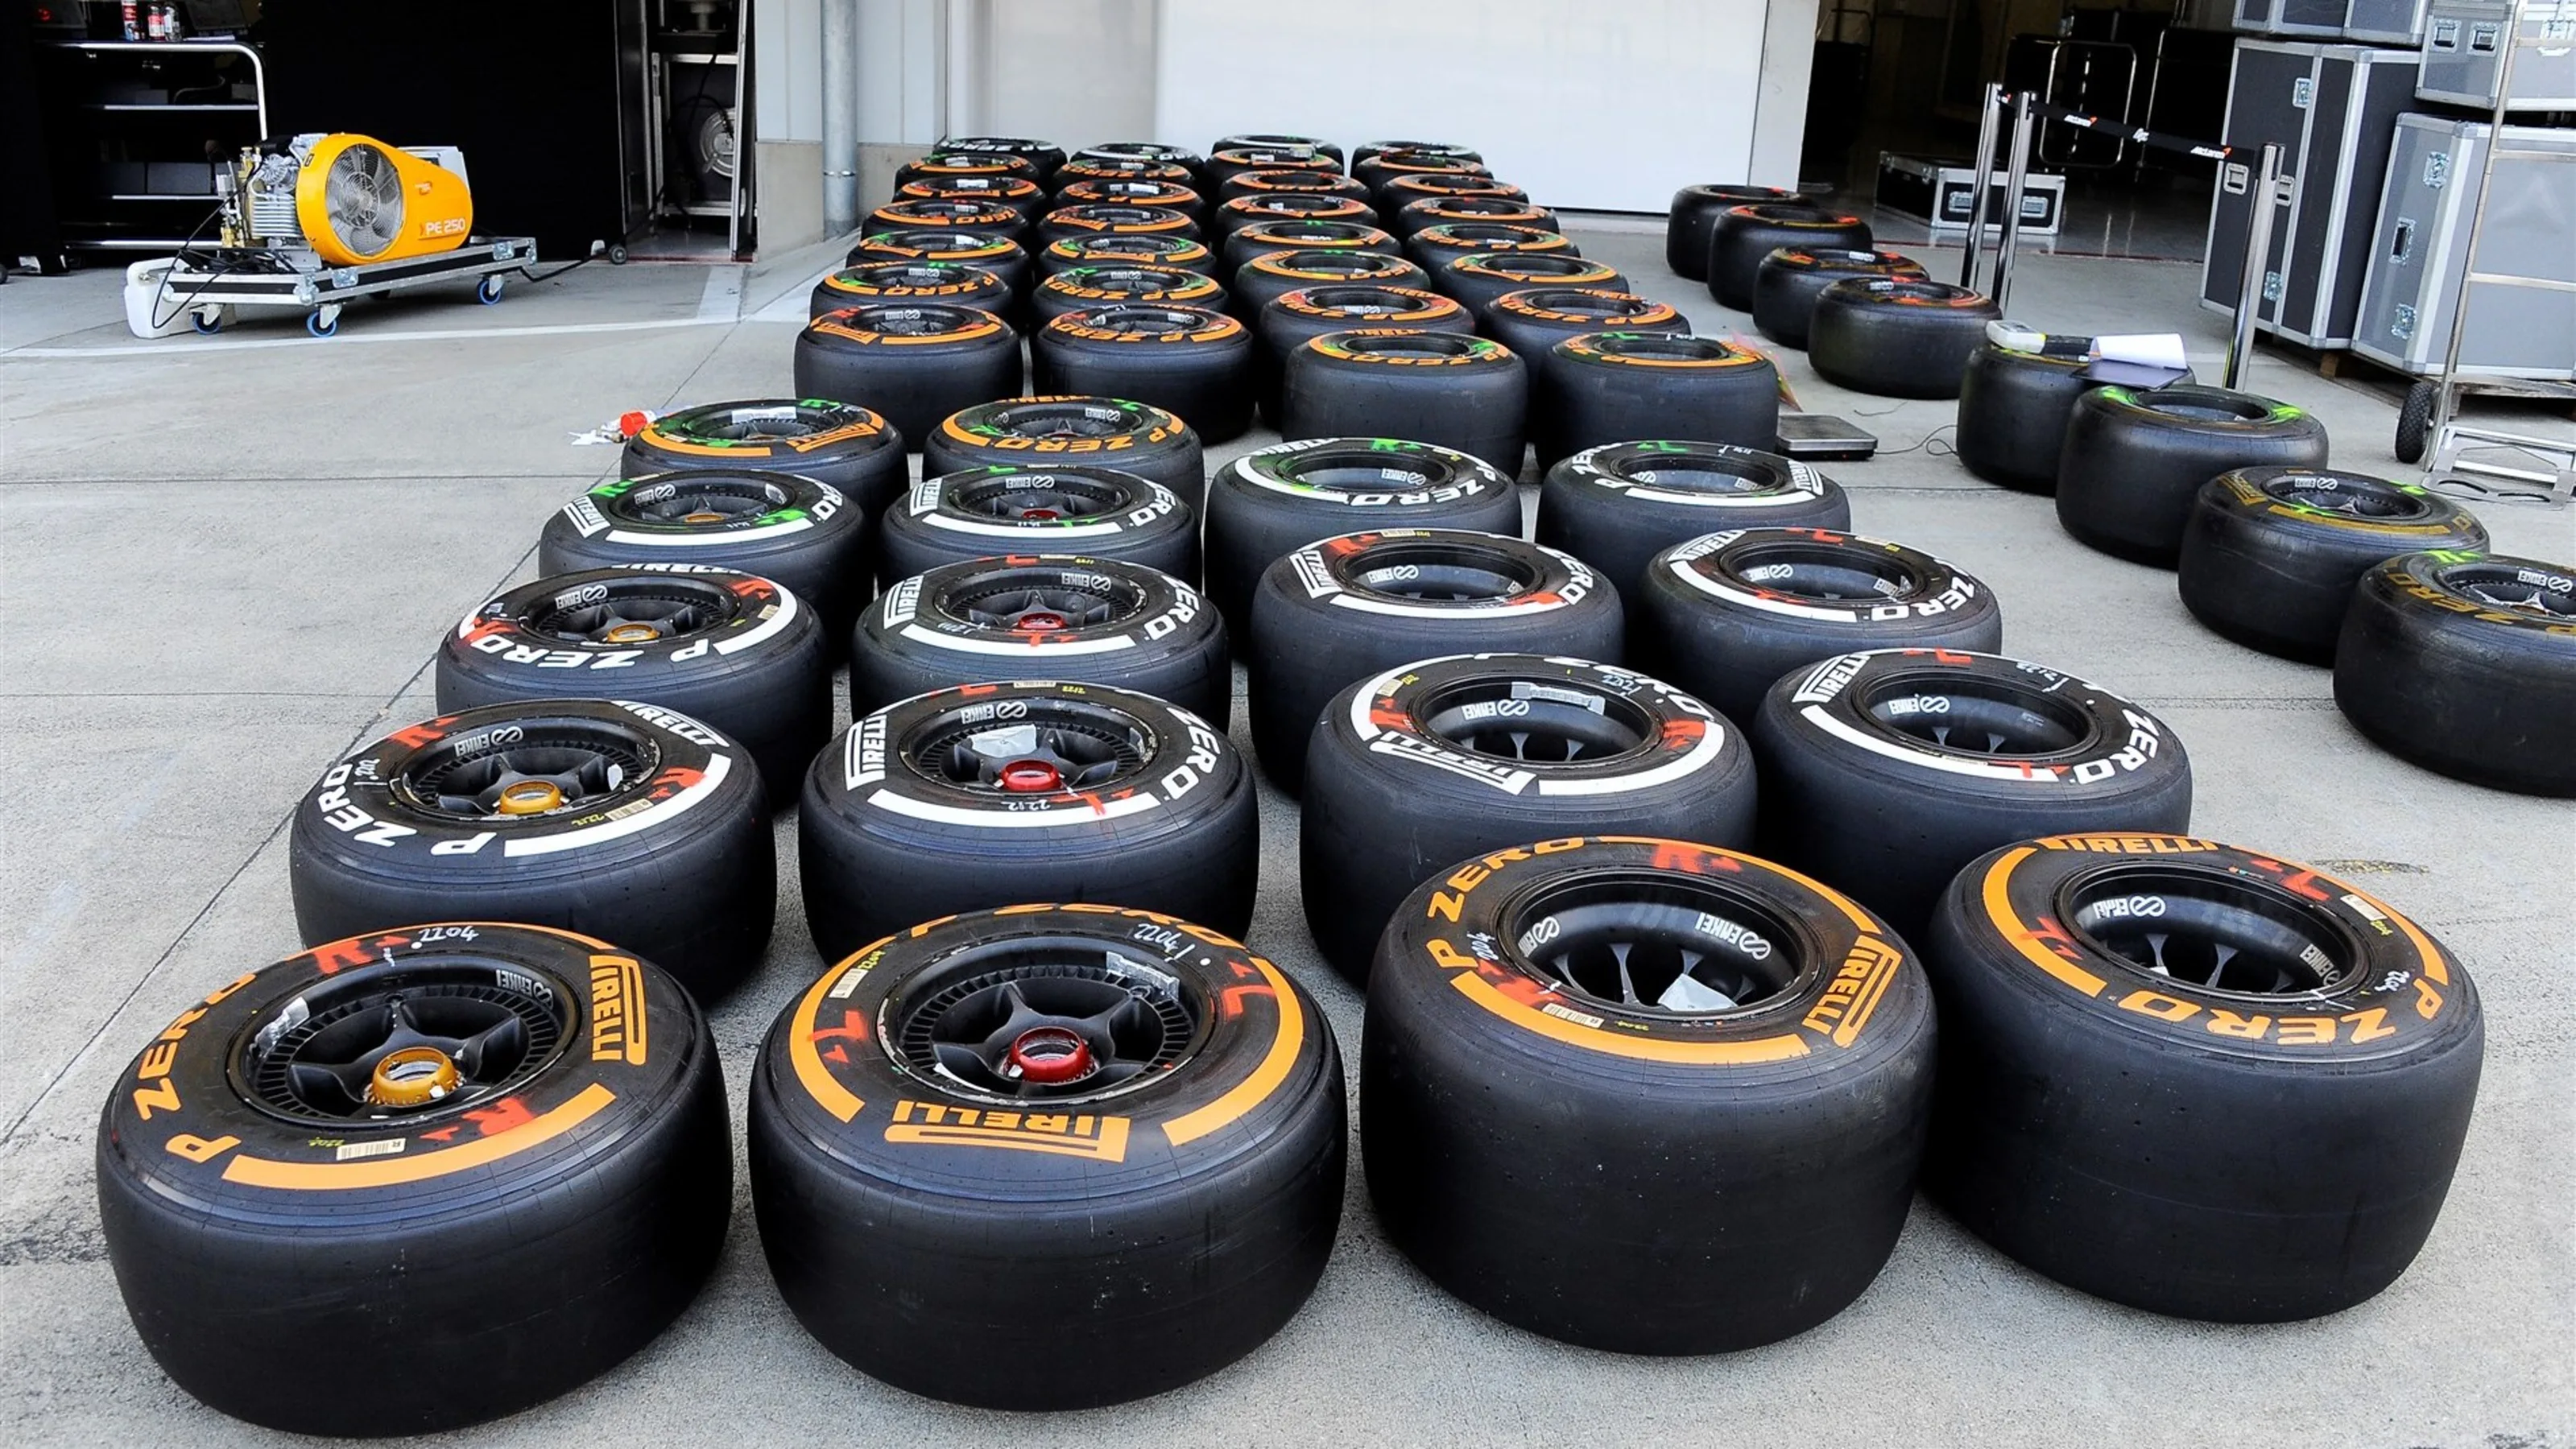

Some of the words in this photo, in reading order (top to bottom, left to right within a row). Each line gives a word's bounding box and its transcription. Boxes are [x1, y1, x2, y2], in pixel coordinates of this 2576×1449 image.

[444, 217, 465, 234] 250
[1055, 324, 1148, 342] ZERO
[994, 436, 1135, 453] ZERO
[1148, 427, 1168, 443] P
[1350, 479, 1486, 506] ZERO
[1667, 527, 1748, 562] PIRELLI
[883, 574, 924, 630] PIRELLI
[1143, 575, 1200, 642] ZERO
[1871, 575, 1974, 621] ZERO
[470, 634, 645, 671] ZERO
[670, 638, 710, 663] P
[1792, 653, 1871, 704] PIRELLI
[611, 700, 730, 748] PIRELLI
[2073, 708, 2160, 785] ZERO
[843, 708, 887, 791] PIRELLI
[1160, 706, 1223, 801] ZERO
[1369, 730, 1537, 796] PIRELLI
[317, 762, 418, 848] ZERO
[429, 831, 498, 857] P
[2034, 832, 2220, 854] PIRELLI
[1427, 836, 1585, 923] ZERO
[418, 925, 481, 943] 2204
[993, 902, 1248, 951] ZERO
[1694, 910, 1743, 946] ENKEI
[1425, 938, 1478, 968] P
[589, 954, 647, 1067] PIRELLI
[1801, 935, 1904, 1049] PIRELLI
[2413, 977, 2444, 1021] P
[2117, 989, 2396, 1046] ZERO
[132, 972, 257, 1121] ZERO
[165, 1133, 242, 1163] P
[884, 1100, 1131, 1163] PIRELLI
